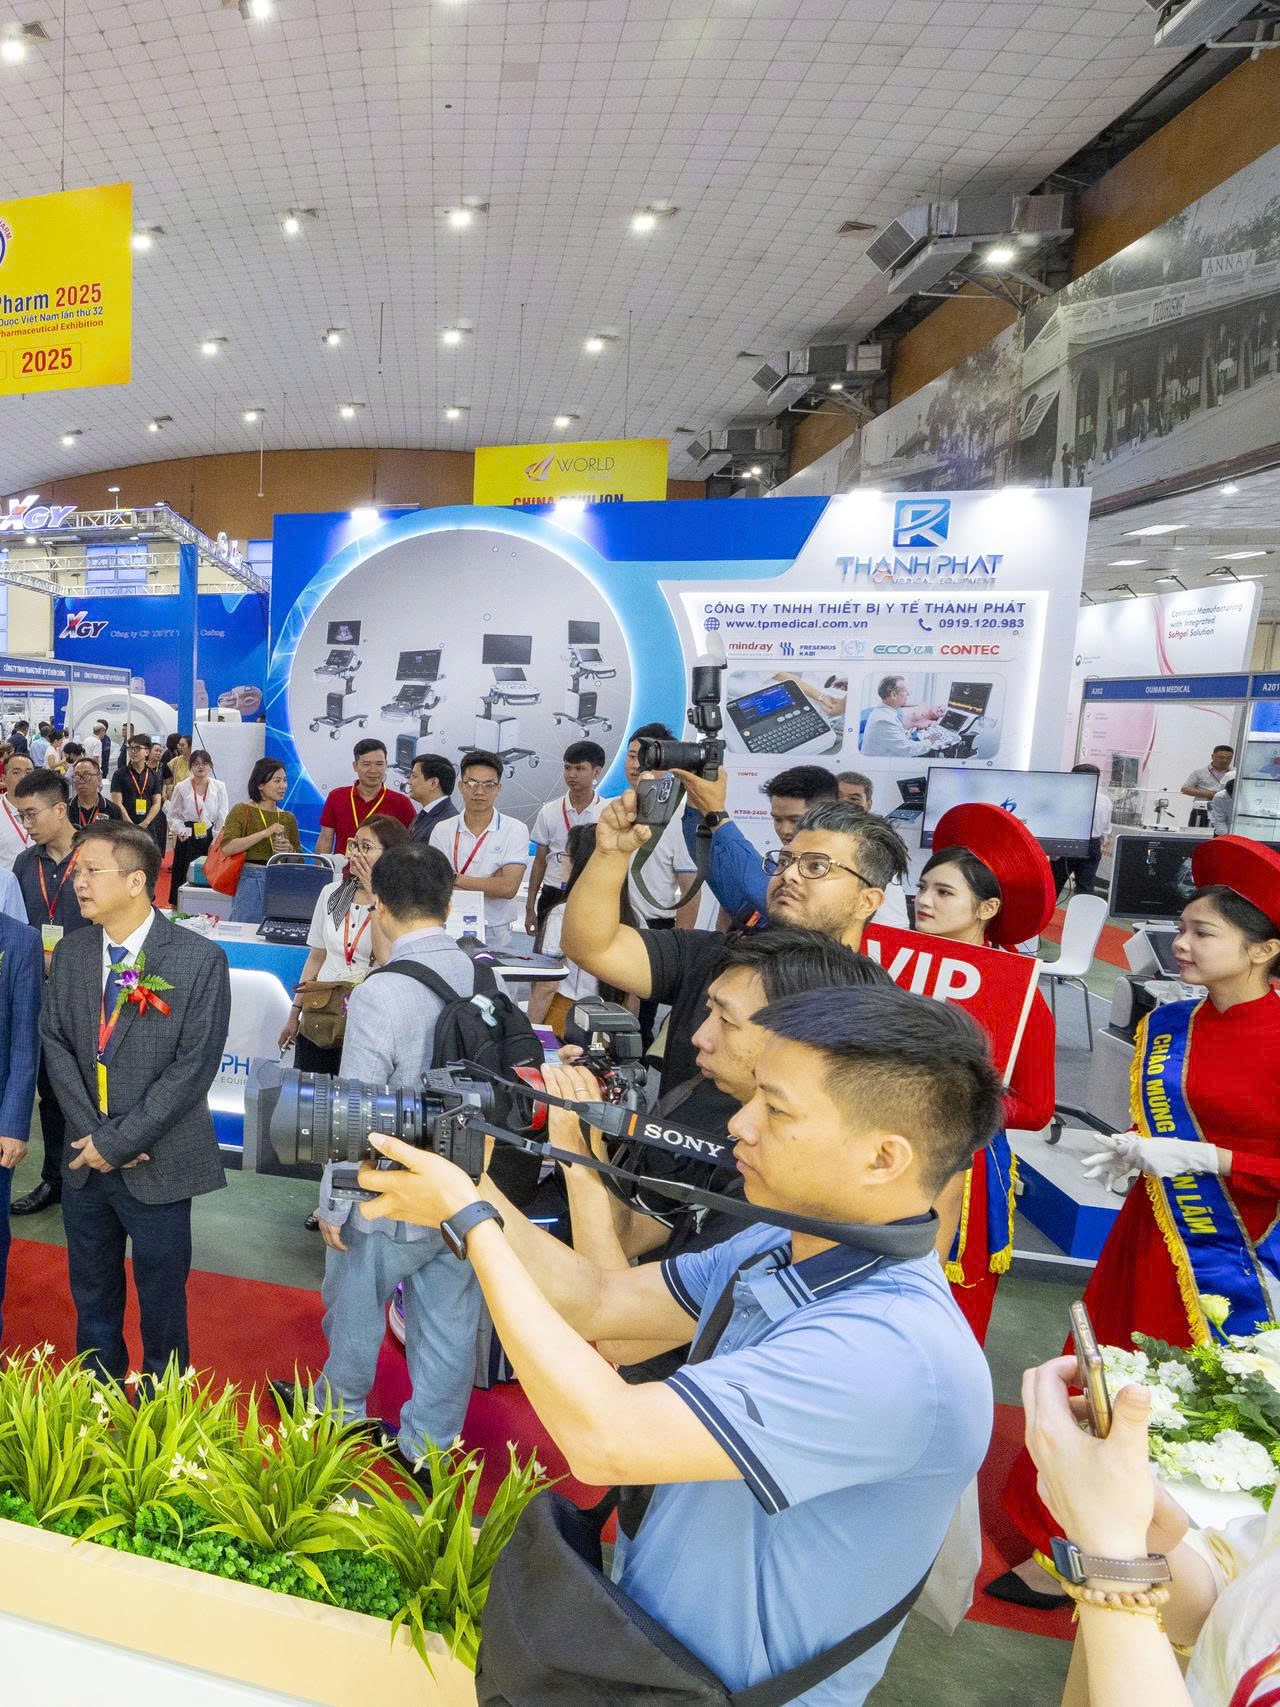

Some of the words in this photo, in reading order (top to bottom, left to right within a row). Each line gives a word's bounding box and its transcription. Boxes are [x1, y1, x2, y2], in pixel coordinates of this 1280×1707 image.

[56, 283, 102, 307] 2025
[21, 314, 38, 326] Việt
[40, 312, 59, 322] Nam
[92, 306, 103, 315] 32
[61, 319, 104, 331] Exhibition
[22, 348, 72, 374] 2025
[556, 456, 615, 472] WORLD
[704, 600, 745, 614] CÔNG
[750, 602, 768, 614] TY
[772, 602, 812, 614] TNHH
[819, 599, 860, 614] THIẾT
[866, 602, 880, 616] BỊ
[886, 602, 895, 614] Y
[900, 598, 920, 614] TẾ
[924, 599, 978, 614] THÀNH
[983, 599, 1026, 614] PHÁT
[1170, 608, 1198, 618] Contract
[1197, 602, 1243, 615] Manufacturing
[58, 610, 109, 639] XGY
[726, 618, 869, 630] www.tpmedical.com.vn
[938, 618, 1025, 629] 0919.120.983
[1170, 619, 1183, 628] with
[1184, 616, 1216, 628] Integrated
[1168, 629, 1189, 640] Softgel
[1190, 628, 1214, 638] Solution
[728, 641, 774, 653] mindray
[872, 644, 910, 655] ECO
[940, 644, 1000, 655] CONTEC
[1166, 685, 1190, 694] MEDICAL
[867, 939, 982, 1004] VIP
[1146, 1033, 1172, 1075] CHÀO
[1146, 1080, 1176, 1132] MỪNG
[643, 1122, 726, 1158] SONY
[1176, 1194, 1218, 1235] LÃM
